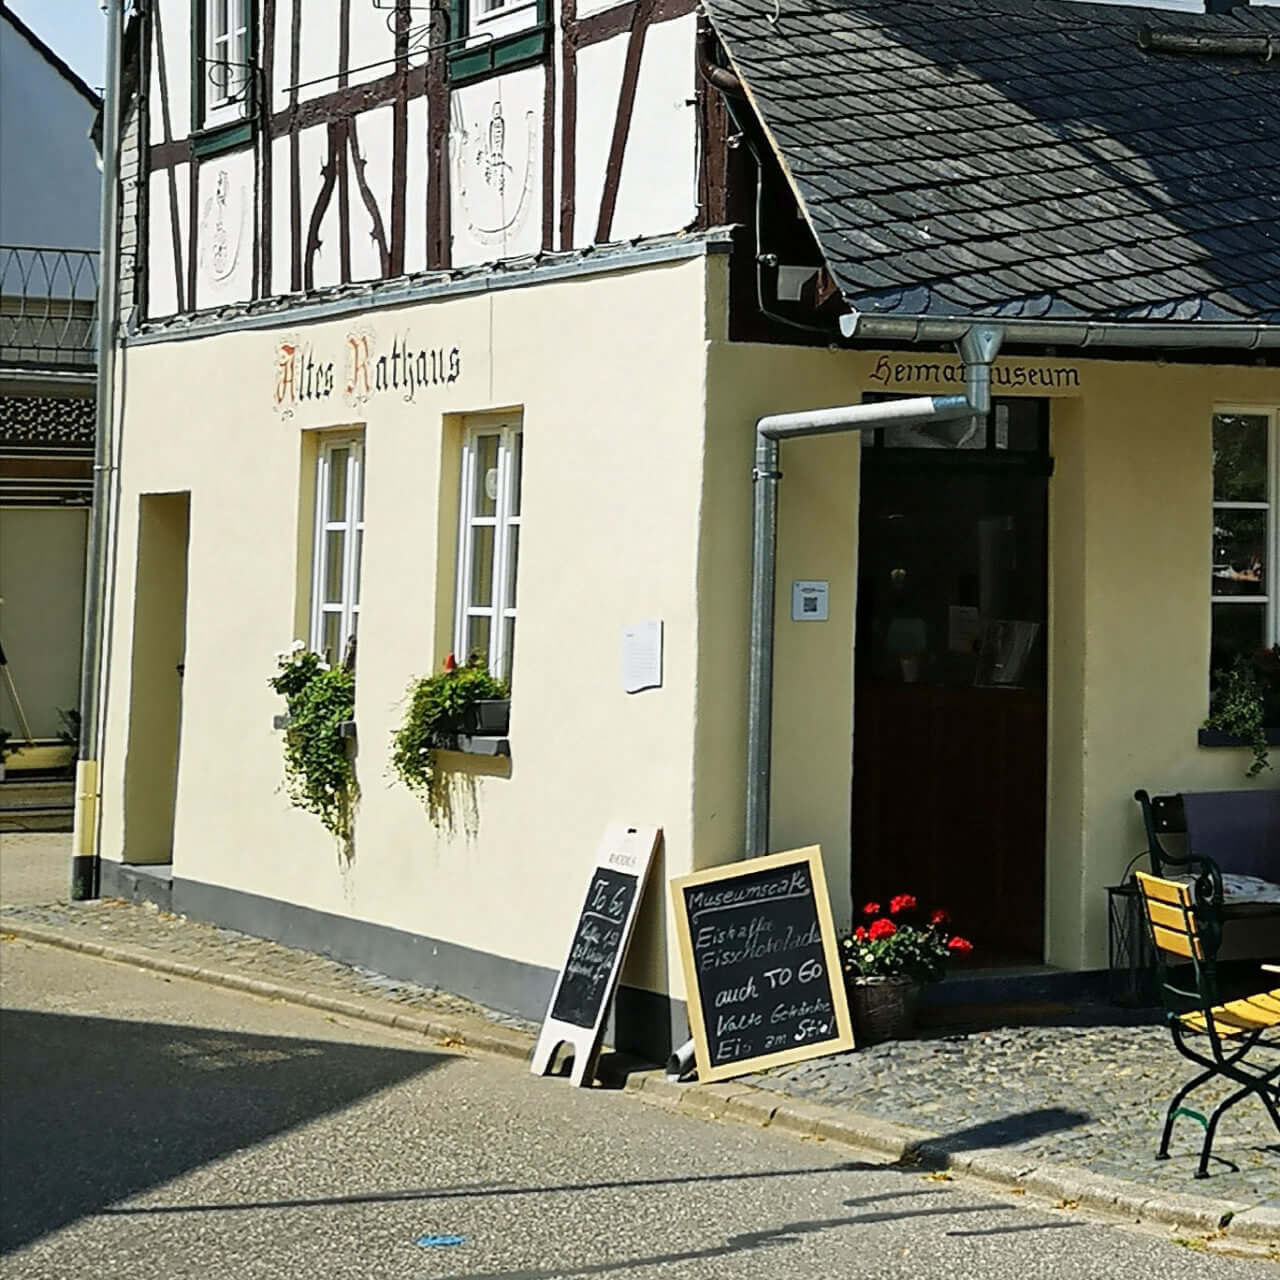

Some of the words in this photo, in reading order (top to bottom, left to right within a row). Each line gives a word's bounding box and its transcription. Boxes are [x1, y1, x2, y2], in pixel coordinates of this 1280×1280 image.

[272, 338, 334, 406] Altes
[345, 331, 461, 403] Rathaus
[868, 354, 1081, 388] Heimatuseum
[715, 976, 758, 1007] auch
